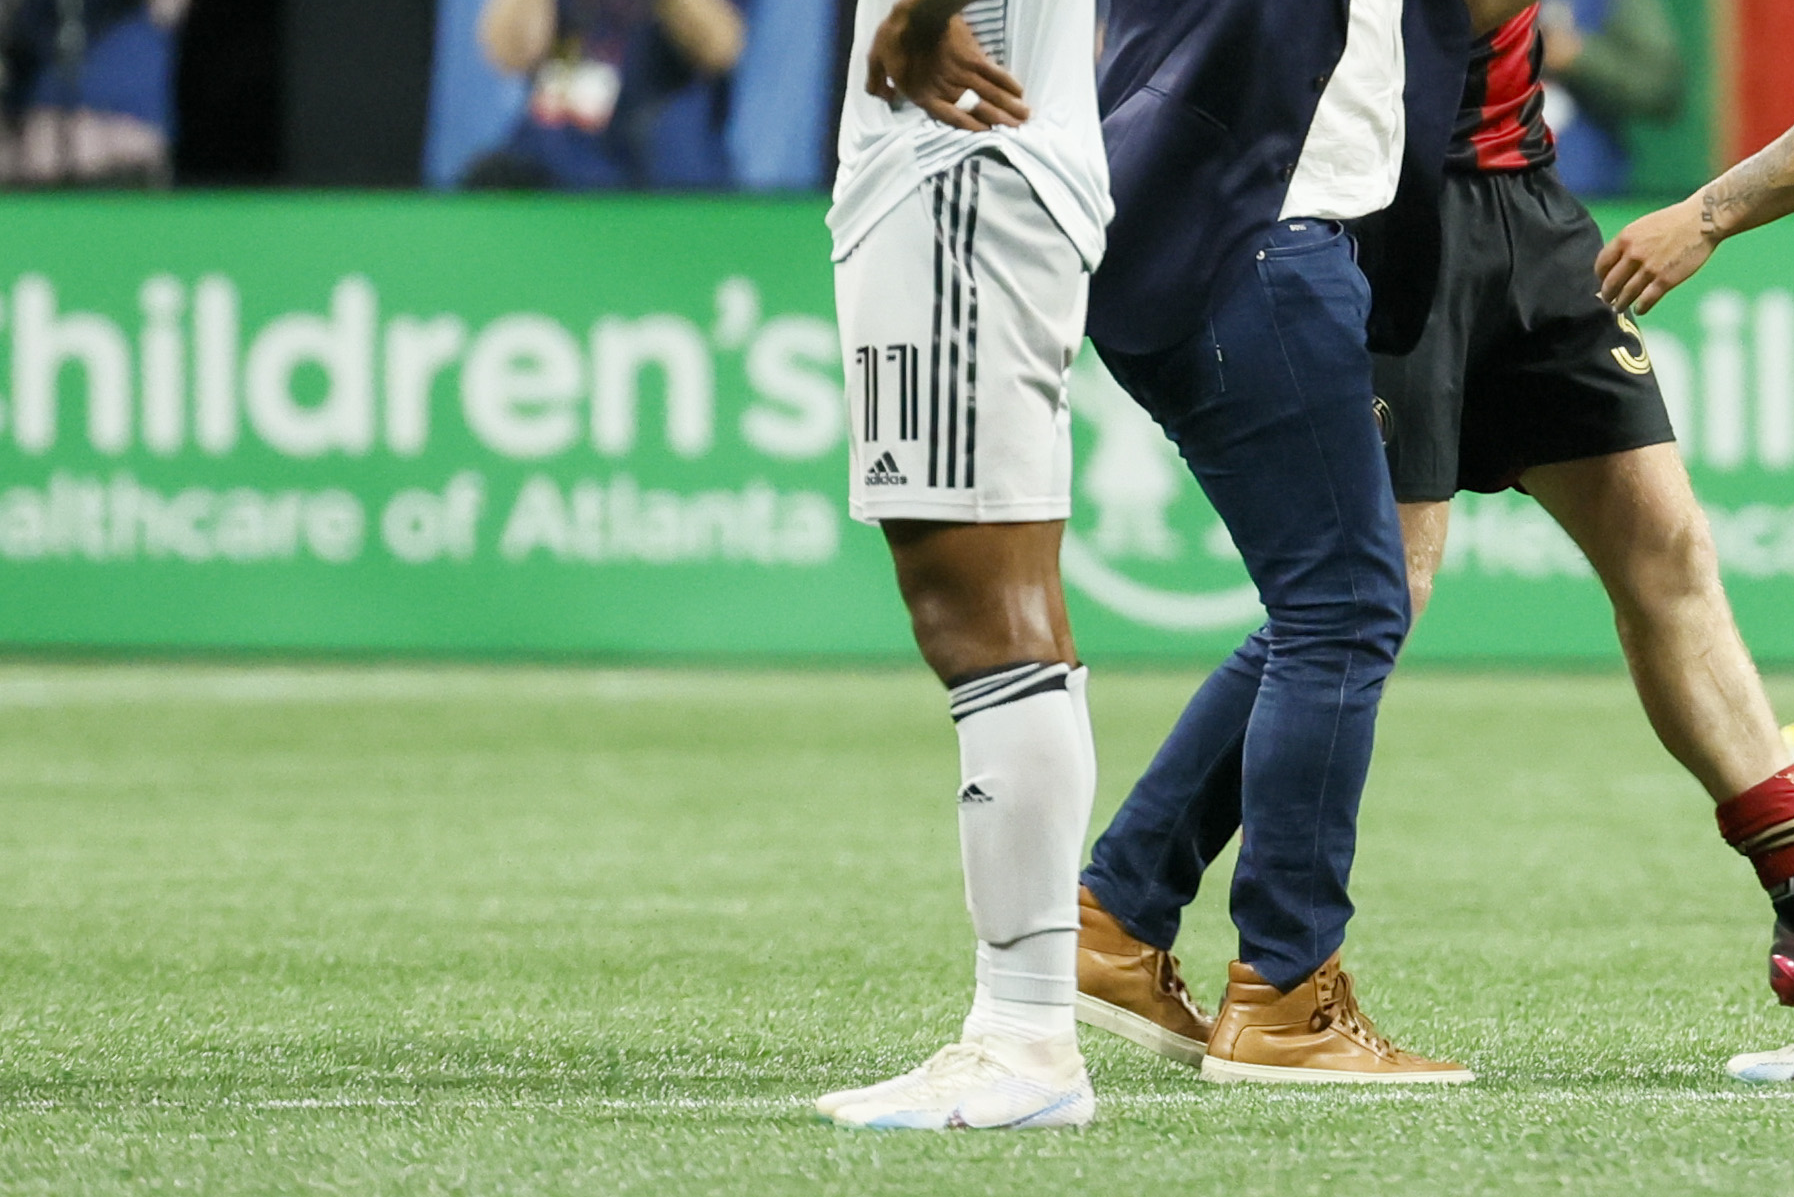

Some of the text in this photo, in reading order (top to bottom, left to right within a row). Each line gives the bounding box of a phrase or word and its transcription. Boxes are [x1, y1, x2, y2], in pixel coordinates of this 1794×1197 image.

[0, 274, 842, 458] hildren's
[856, 344, 918, 442] 11
[498, 474, 840, 566] Atlanta
[864, 473, 908, 486] adidas
